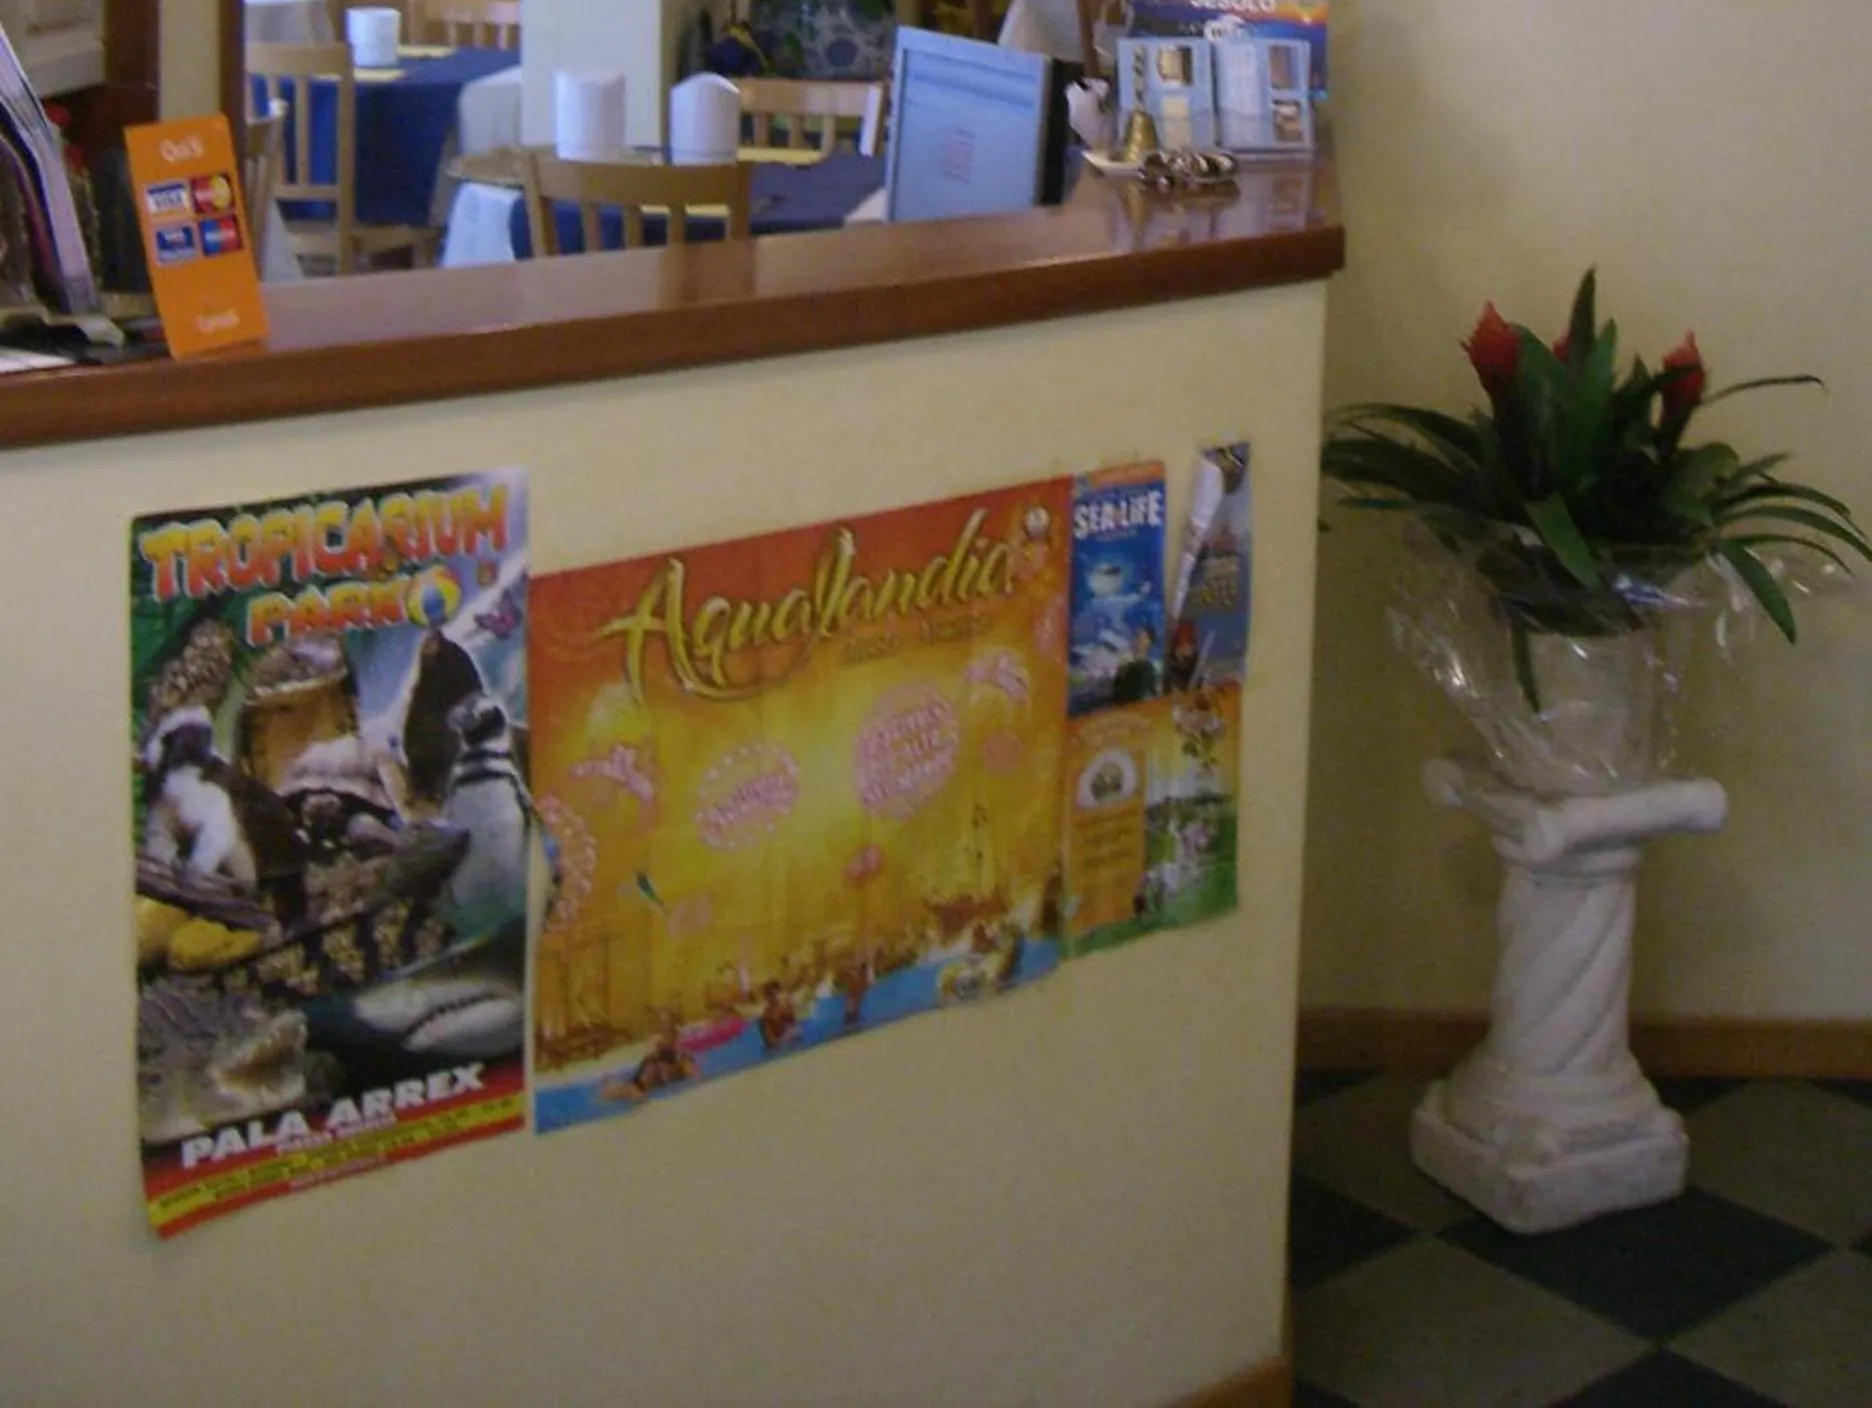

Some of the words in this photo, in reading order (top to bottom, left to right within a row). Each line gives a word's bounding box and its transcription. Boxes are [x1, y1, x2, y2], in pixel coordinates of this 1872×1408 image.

[138, 484, 509, 603] TROPICARIUM
[246, 574, 410, 648] PARK
[597, 505, 1017, 704] Aqualandia
[180, 1109, 310, 1169] PALA
[326, 1061, 485, 1132] ARREX
